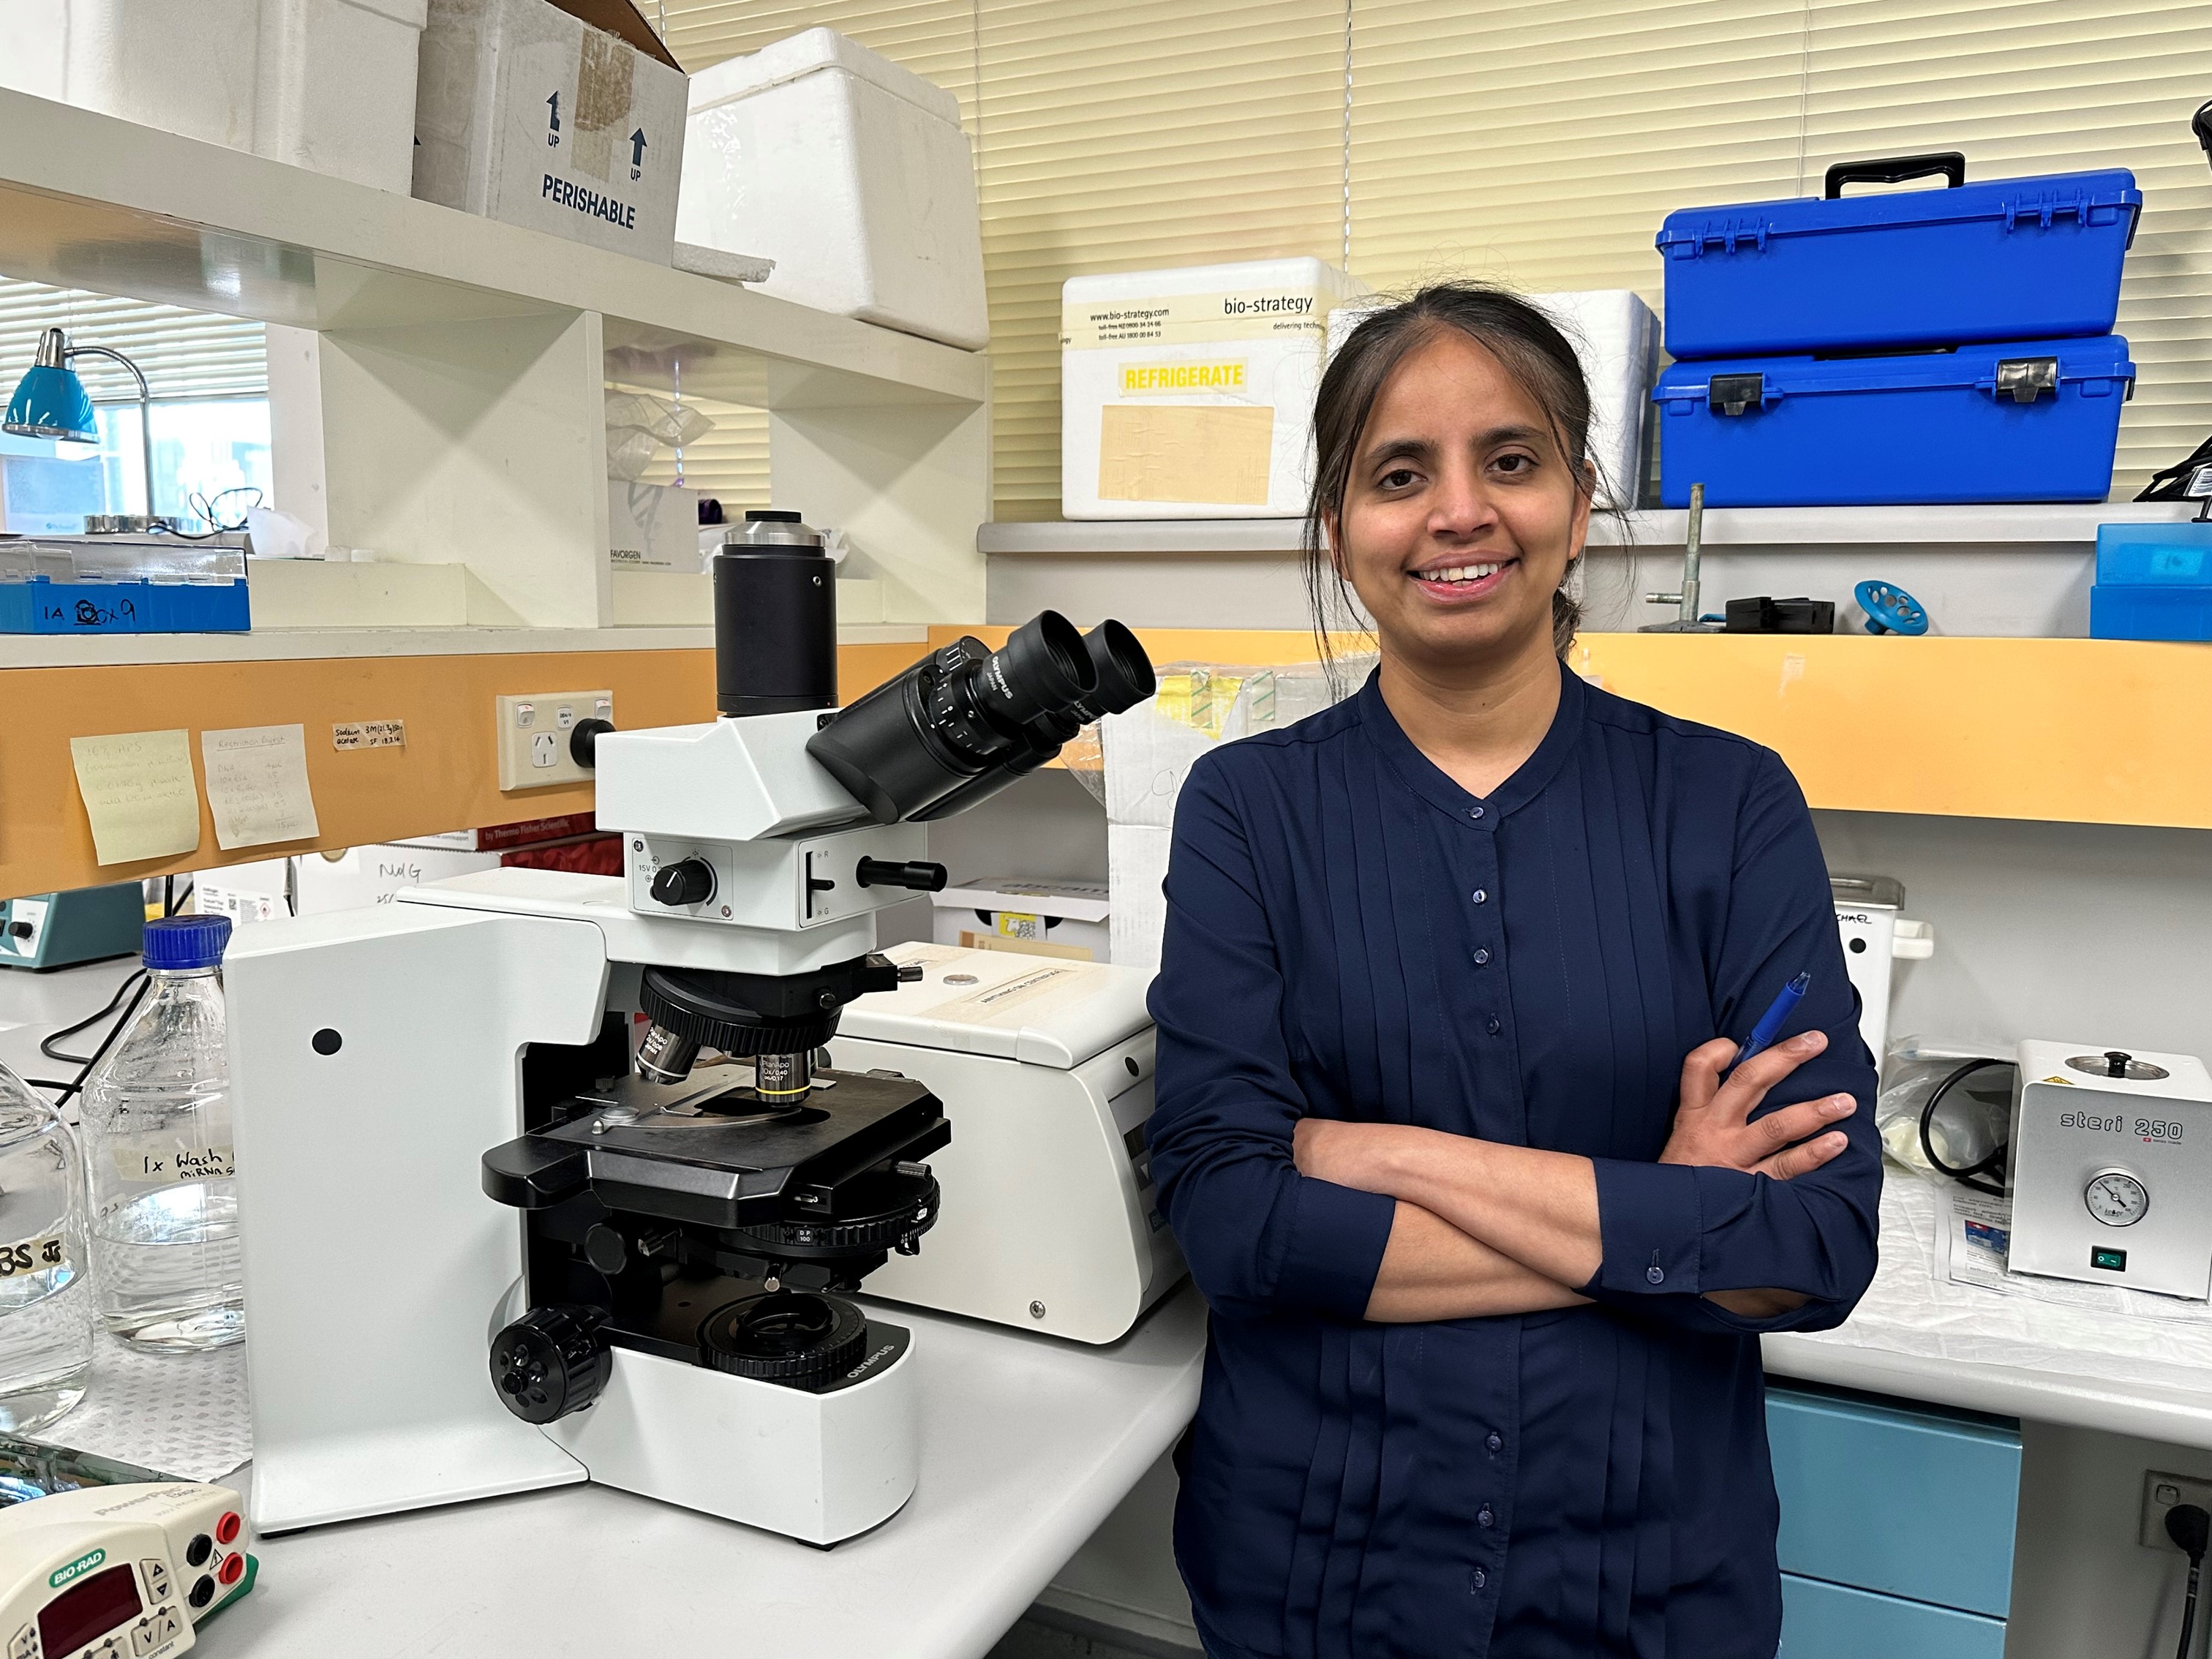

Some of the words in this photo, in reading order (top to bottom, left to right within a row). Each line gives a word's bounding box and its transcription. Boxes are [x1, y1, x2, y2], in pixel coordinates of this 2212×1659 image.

[548, 133, 560, 148] UP
[631, 168, 641, 181] UP
[542, 173, 636, 230] PERISHABLE
[1090, 309, 1170, 321] www.bio-strategy.com
[1224, 296, 1313, 315] bio-strategy
[1273, 322, 1302, 331] delivering
[1126, 364, 1244, 389] REFRIGERATE
[610, 549, 641, 560] FAVORGEN
[992, 655, 1014, 699] OLYMPUS
[485, 831, 494, 841] by
[494, 828, 520, 839] Thermo
[520, 824, 540, 835] Fisher
[2060, 1111, 2123, 1132] steri
[2134, 1118, 2183, 1140] 250
[176, 1148, 222, 1167] Wash
[846, 1344, 895, 1378] OLYMPUS
[144, 1631, 152, 1644] V
[168, 1620, 176, 1632] A
[148, 1641, 175, 1659] constant
